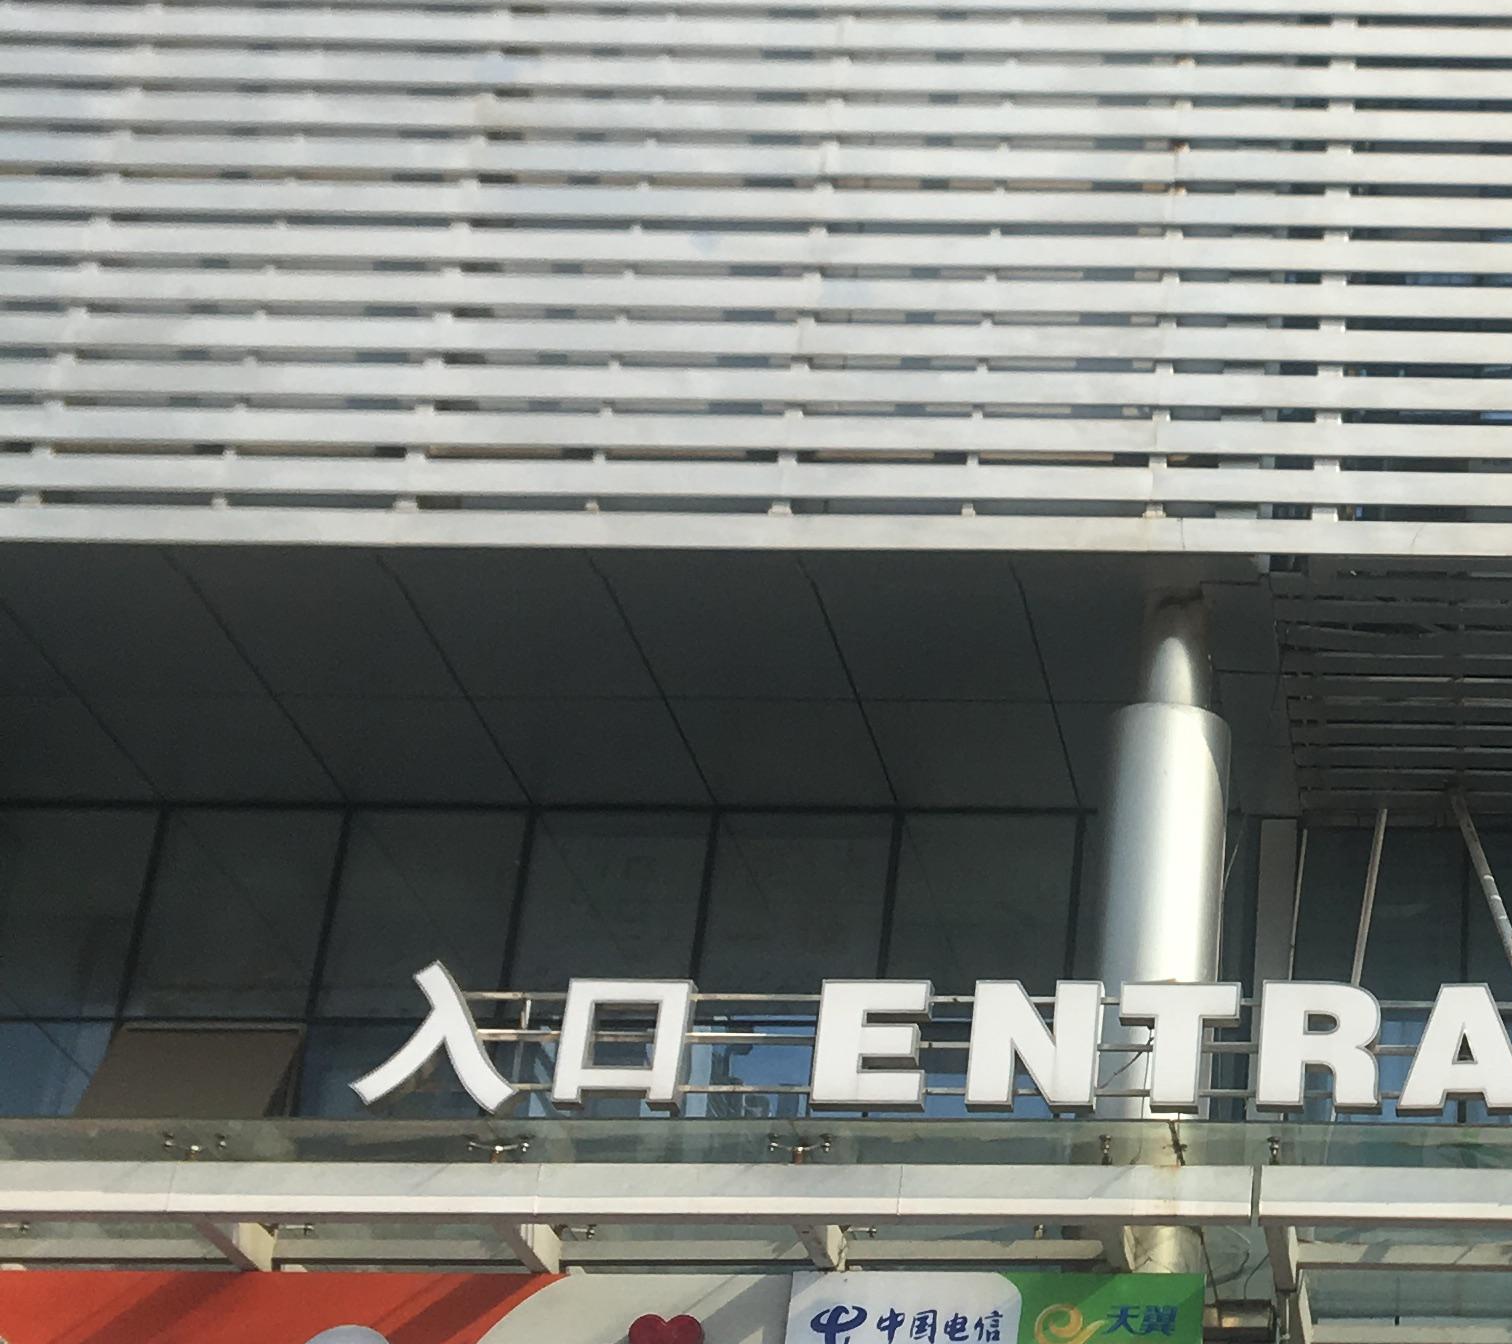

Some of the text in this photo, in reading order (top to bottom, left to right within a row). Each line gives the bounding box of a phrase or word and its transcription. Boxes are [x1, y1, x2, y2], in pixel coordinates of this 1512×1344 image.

[349, 960, 699, 1114] 入口
[876, 1308, 1003, 1344] 中国电信
